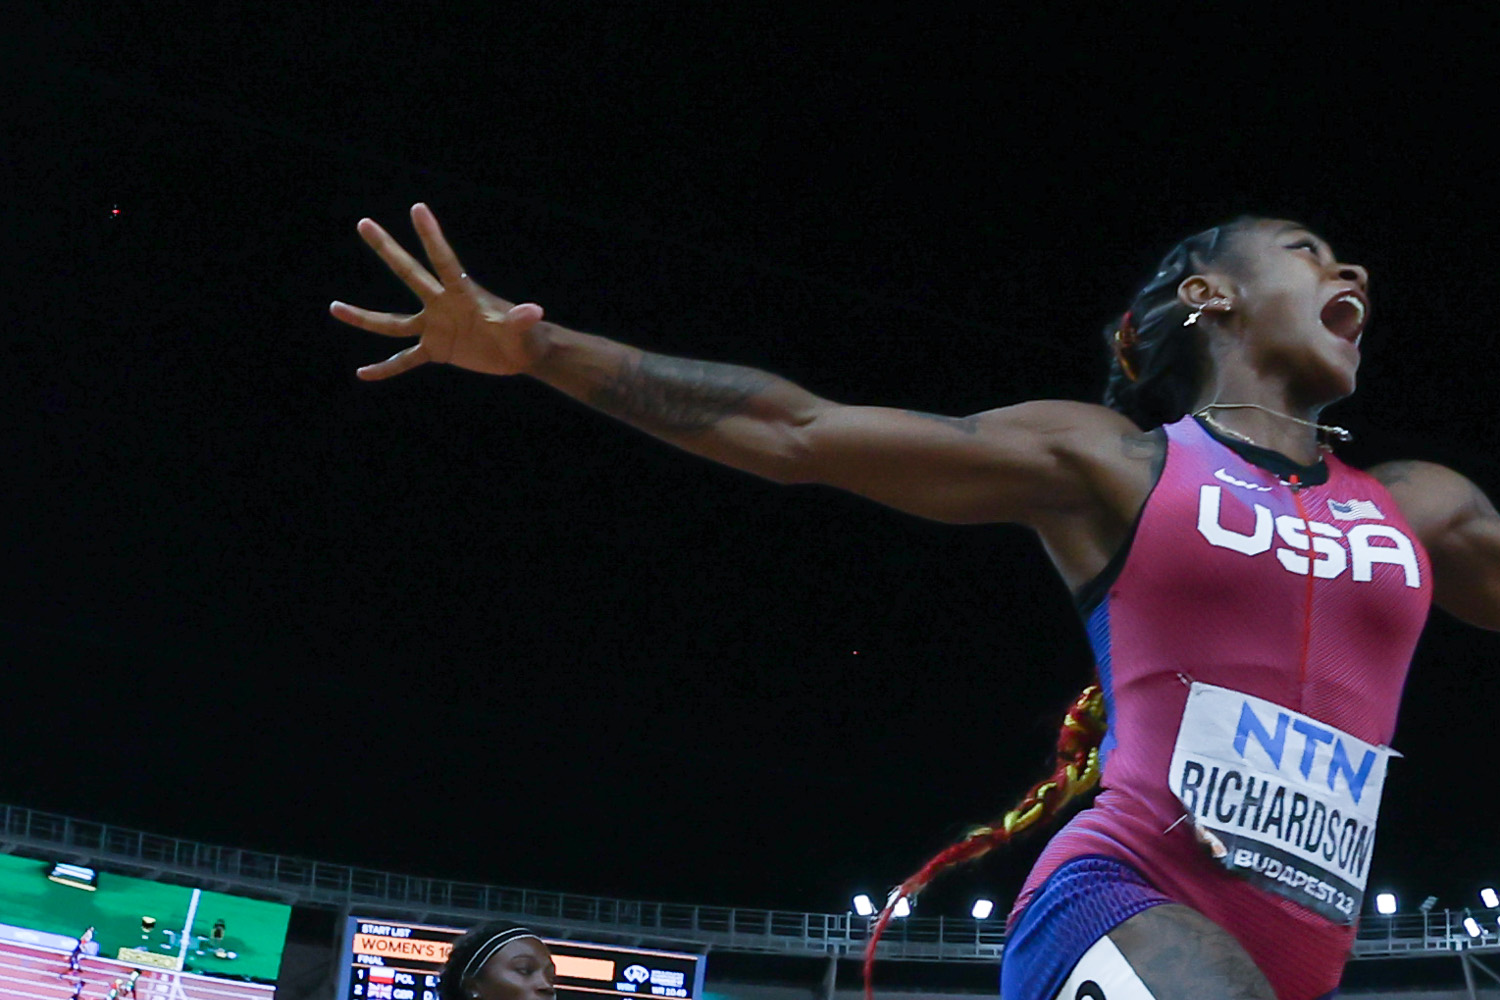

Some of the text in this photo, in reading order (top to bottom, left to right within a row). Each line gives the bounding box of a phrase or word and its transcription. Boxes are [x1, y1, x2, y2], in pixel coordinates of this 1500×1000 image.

[1197, 485, 1420, 588] USA
[1233, 700, 1377, 807] NTN
[1181, 760, 1375, 879] RICHARDSON
[1233, 849, 1337, 904] BUDAPEST
[357, 954, 384, 966] FINAL
[361, 937, 435, 957] WOMEN'S
[353, 984, 363, 995] 2
